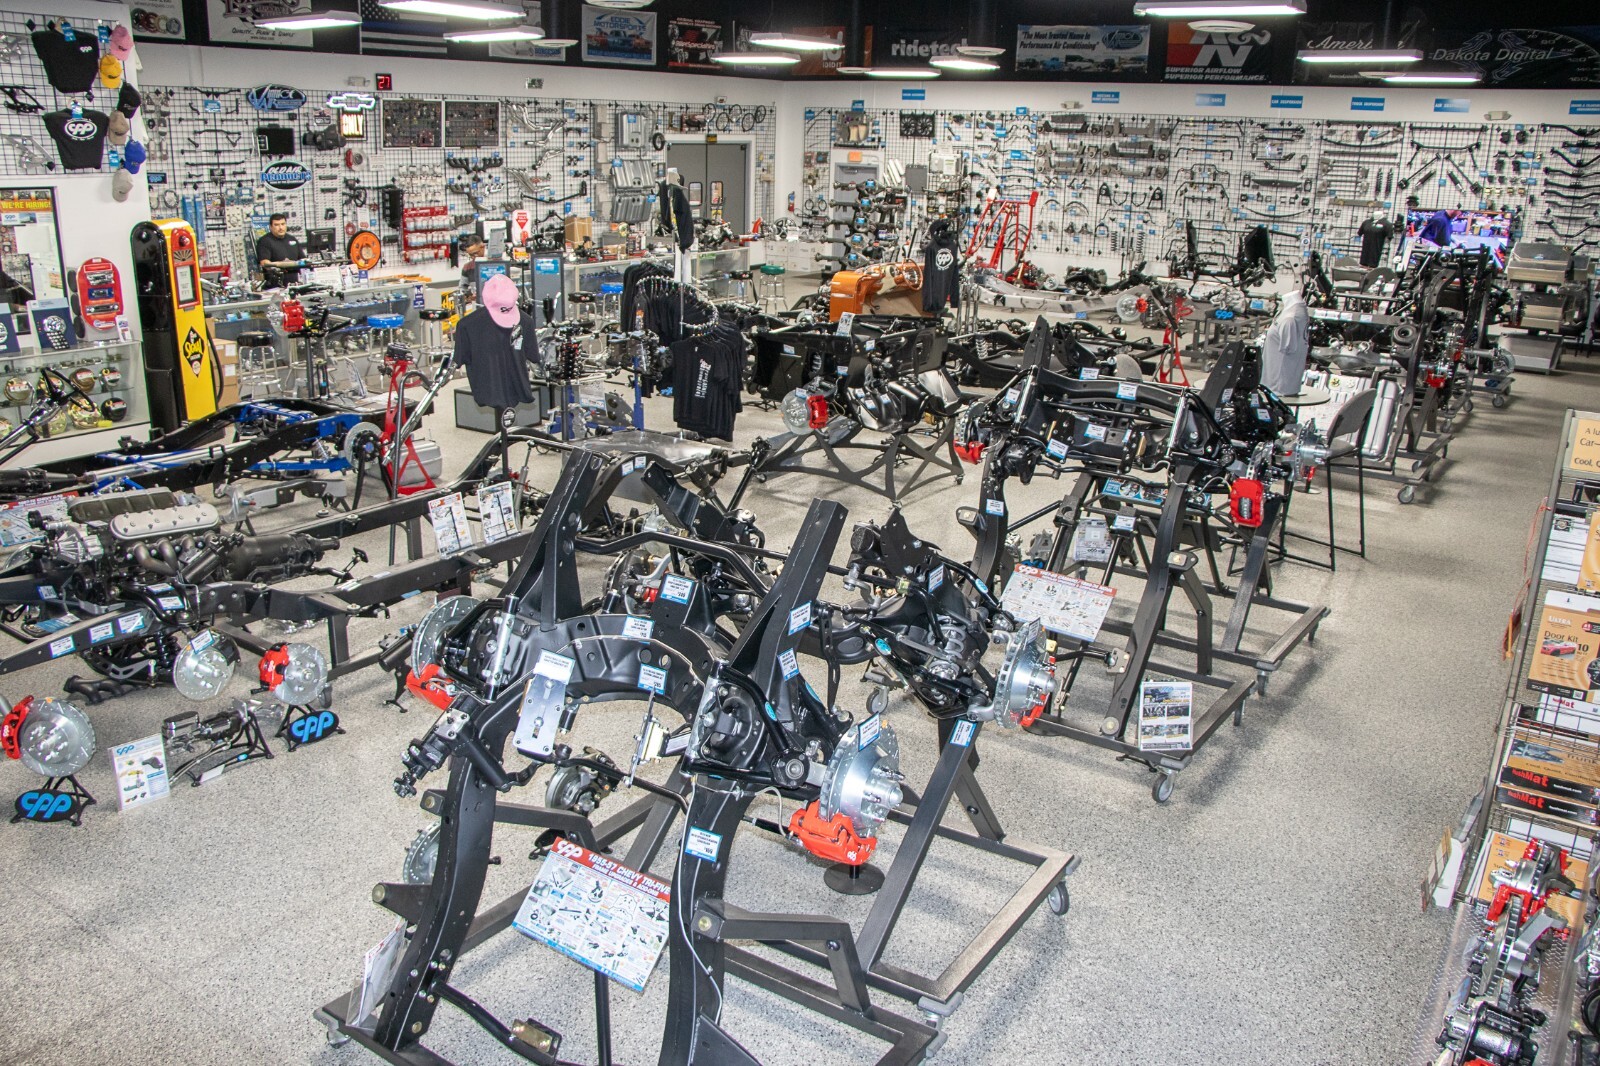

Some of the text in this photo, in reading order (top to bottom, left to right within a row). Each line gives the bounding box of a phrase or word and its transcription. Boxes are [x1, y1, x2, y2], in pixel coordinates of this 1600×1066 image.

[594, 20, 647, 32] MOTORSPORTS
[1432, 48, 1554, 62] Dakota Digital
[377, 76, 390, 88] 27
[342, 114, 363, 136] ONLY
[260, 170, 312, 182] PRODUCTS
[26, 201, 51, 209] HIRING!
[1548, 616, 1571, 624] ULTRA
[1544, 630, 1578, 642] Door Kit
[1578, 644, 1589, 652] 10
[1567, 754, 1597, 764] Trunk
[588, 854, 618, 872] 1955-57
[617, 865, 643, 882] CHEVY
[642, 874, 670, 895] TRI-FIVE
